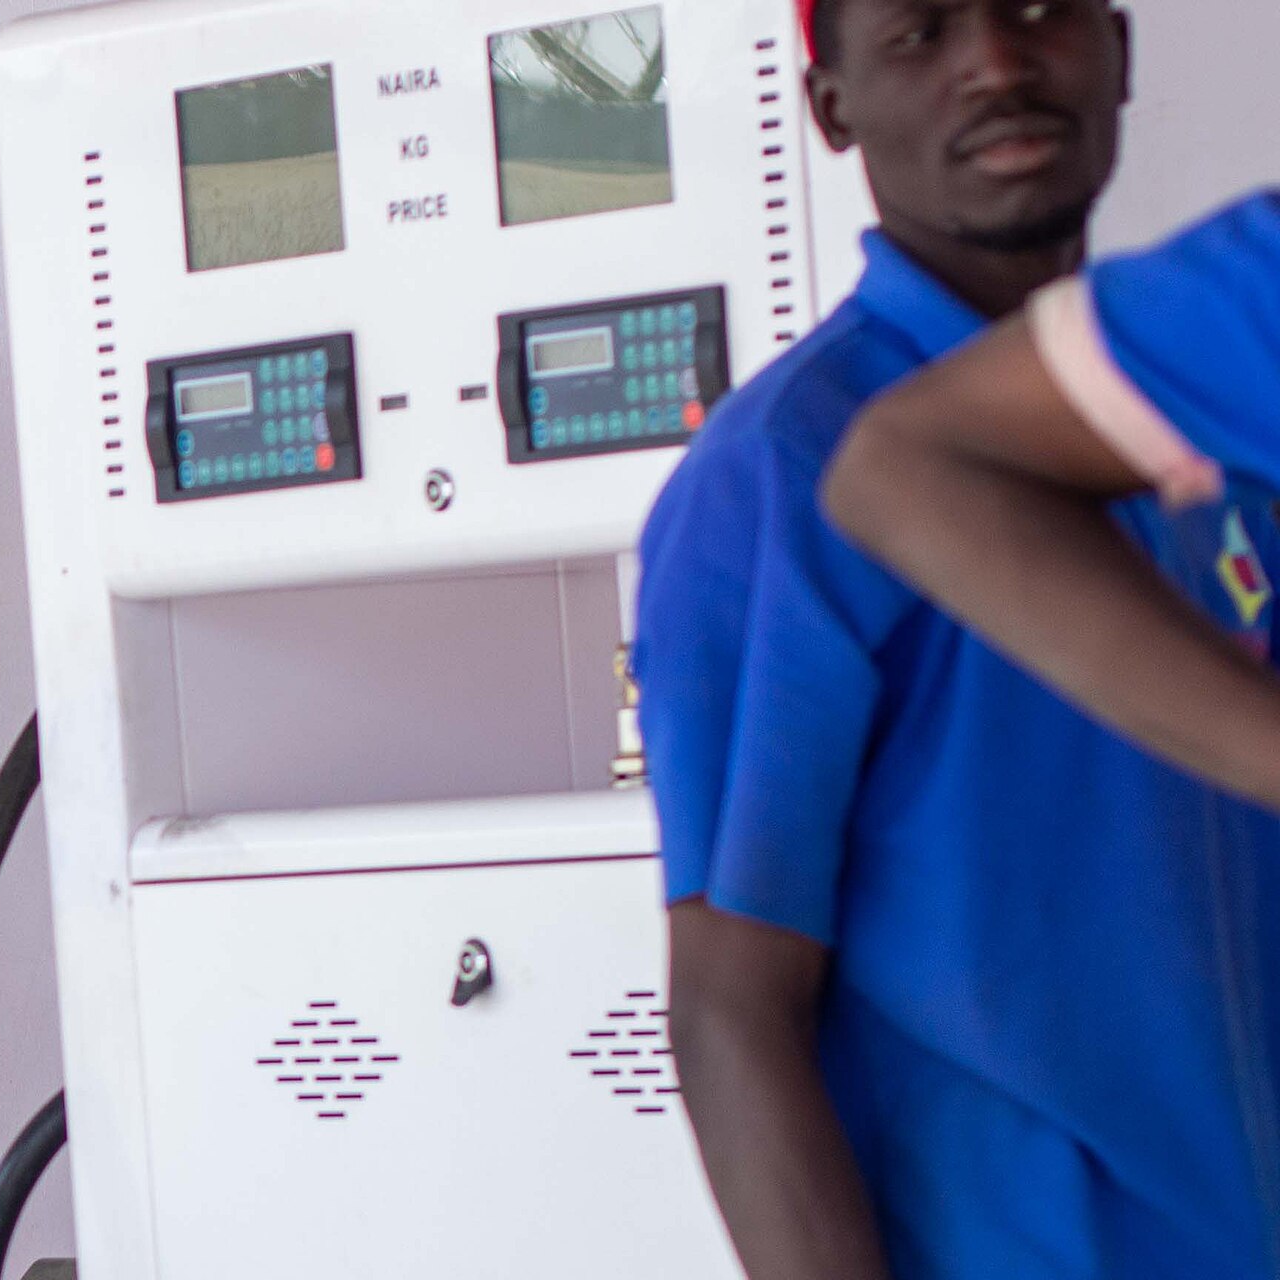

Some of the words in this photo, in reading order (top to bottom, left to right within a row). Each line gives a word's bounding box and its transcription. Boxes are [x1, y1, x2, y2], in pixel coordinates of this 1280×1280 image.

[377, 68, 440, 98] NAIRA
[399, 134, 429, 160] KG
[387, 194, 447, 223] PRICE
